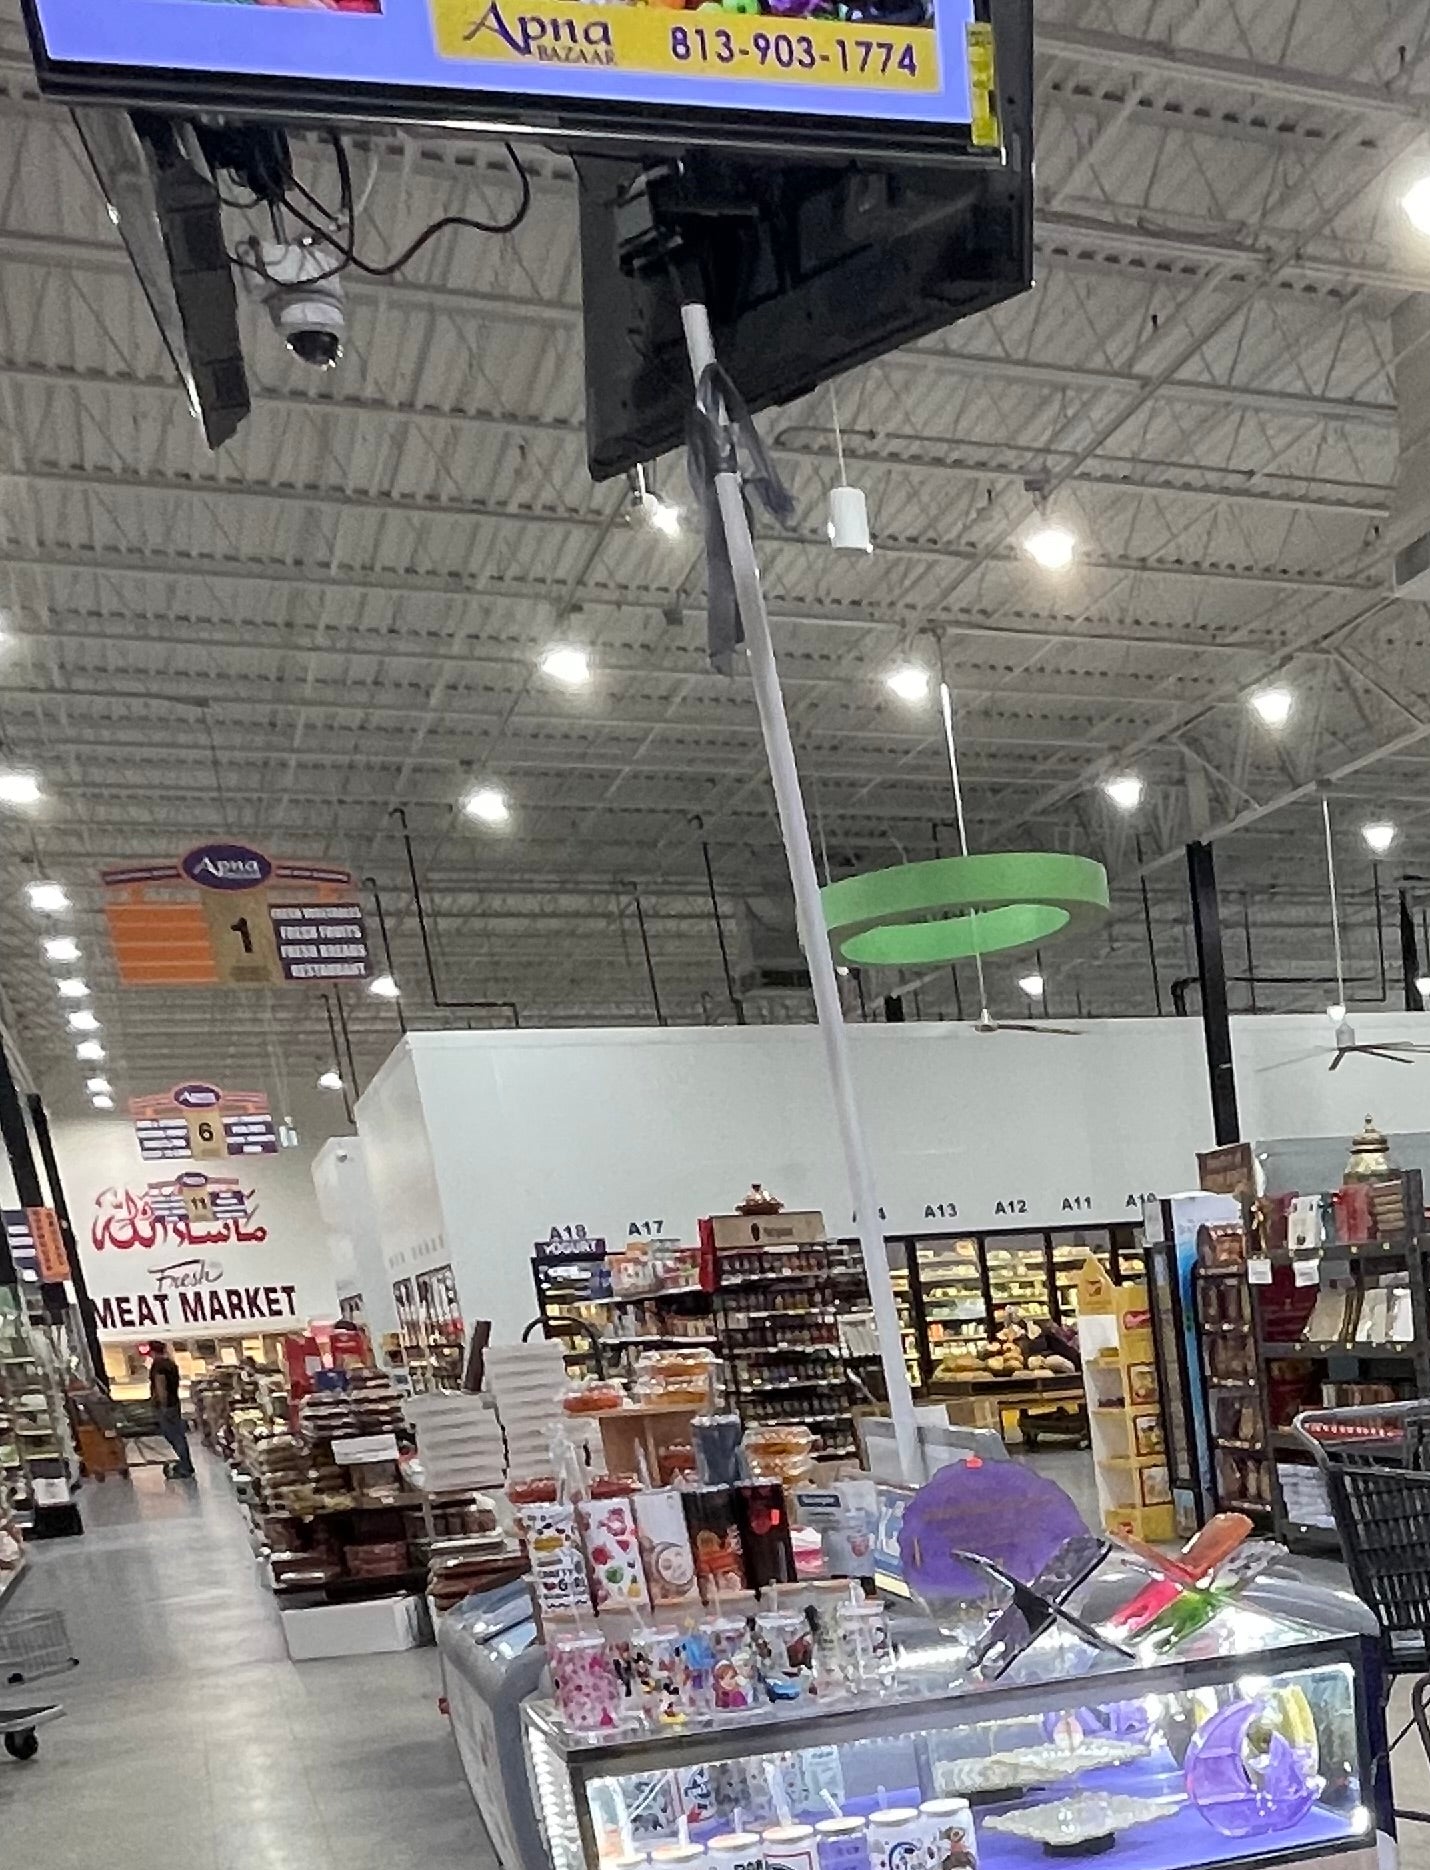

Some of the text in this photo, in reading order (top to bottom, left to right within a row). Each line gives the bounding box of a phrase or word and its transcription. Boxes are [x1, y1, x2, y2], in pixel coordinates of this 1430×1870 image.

[463, 0, 611, 56] Apna
[537, 44, 616, 66] BAZAAR
[670, 26, 918, 77] 813-903-1774
[193, 855, 261, 878] Apna
[229, 916, 254, 954] 1
[198, 1122, 214, 1142] 6
[923, 1203, 960, 1219] A13
[994, 1199, 1029, 1217] A12
[1061, 1196, 1094, 1212] A11
[628, 1219, 664, 1236] A17
[147, 1258, 224, 1293] Fresh
[93, 1284, 297, 1330] MEAT MARKET
